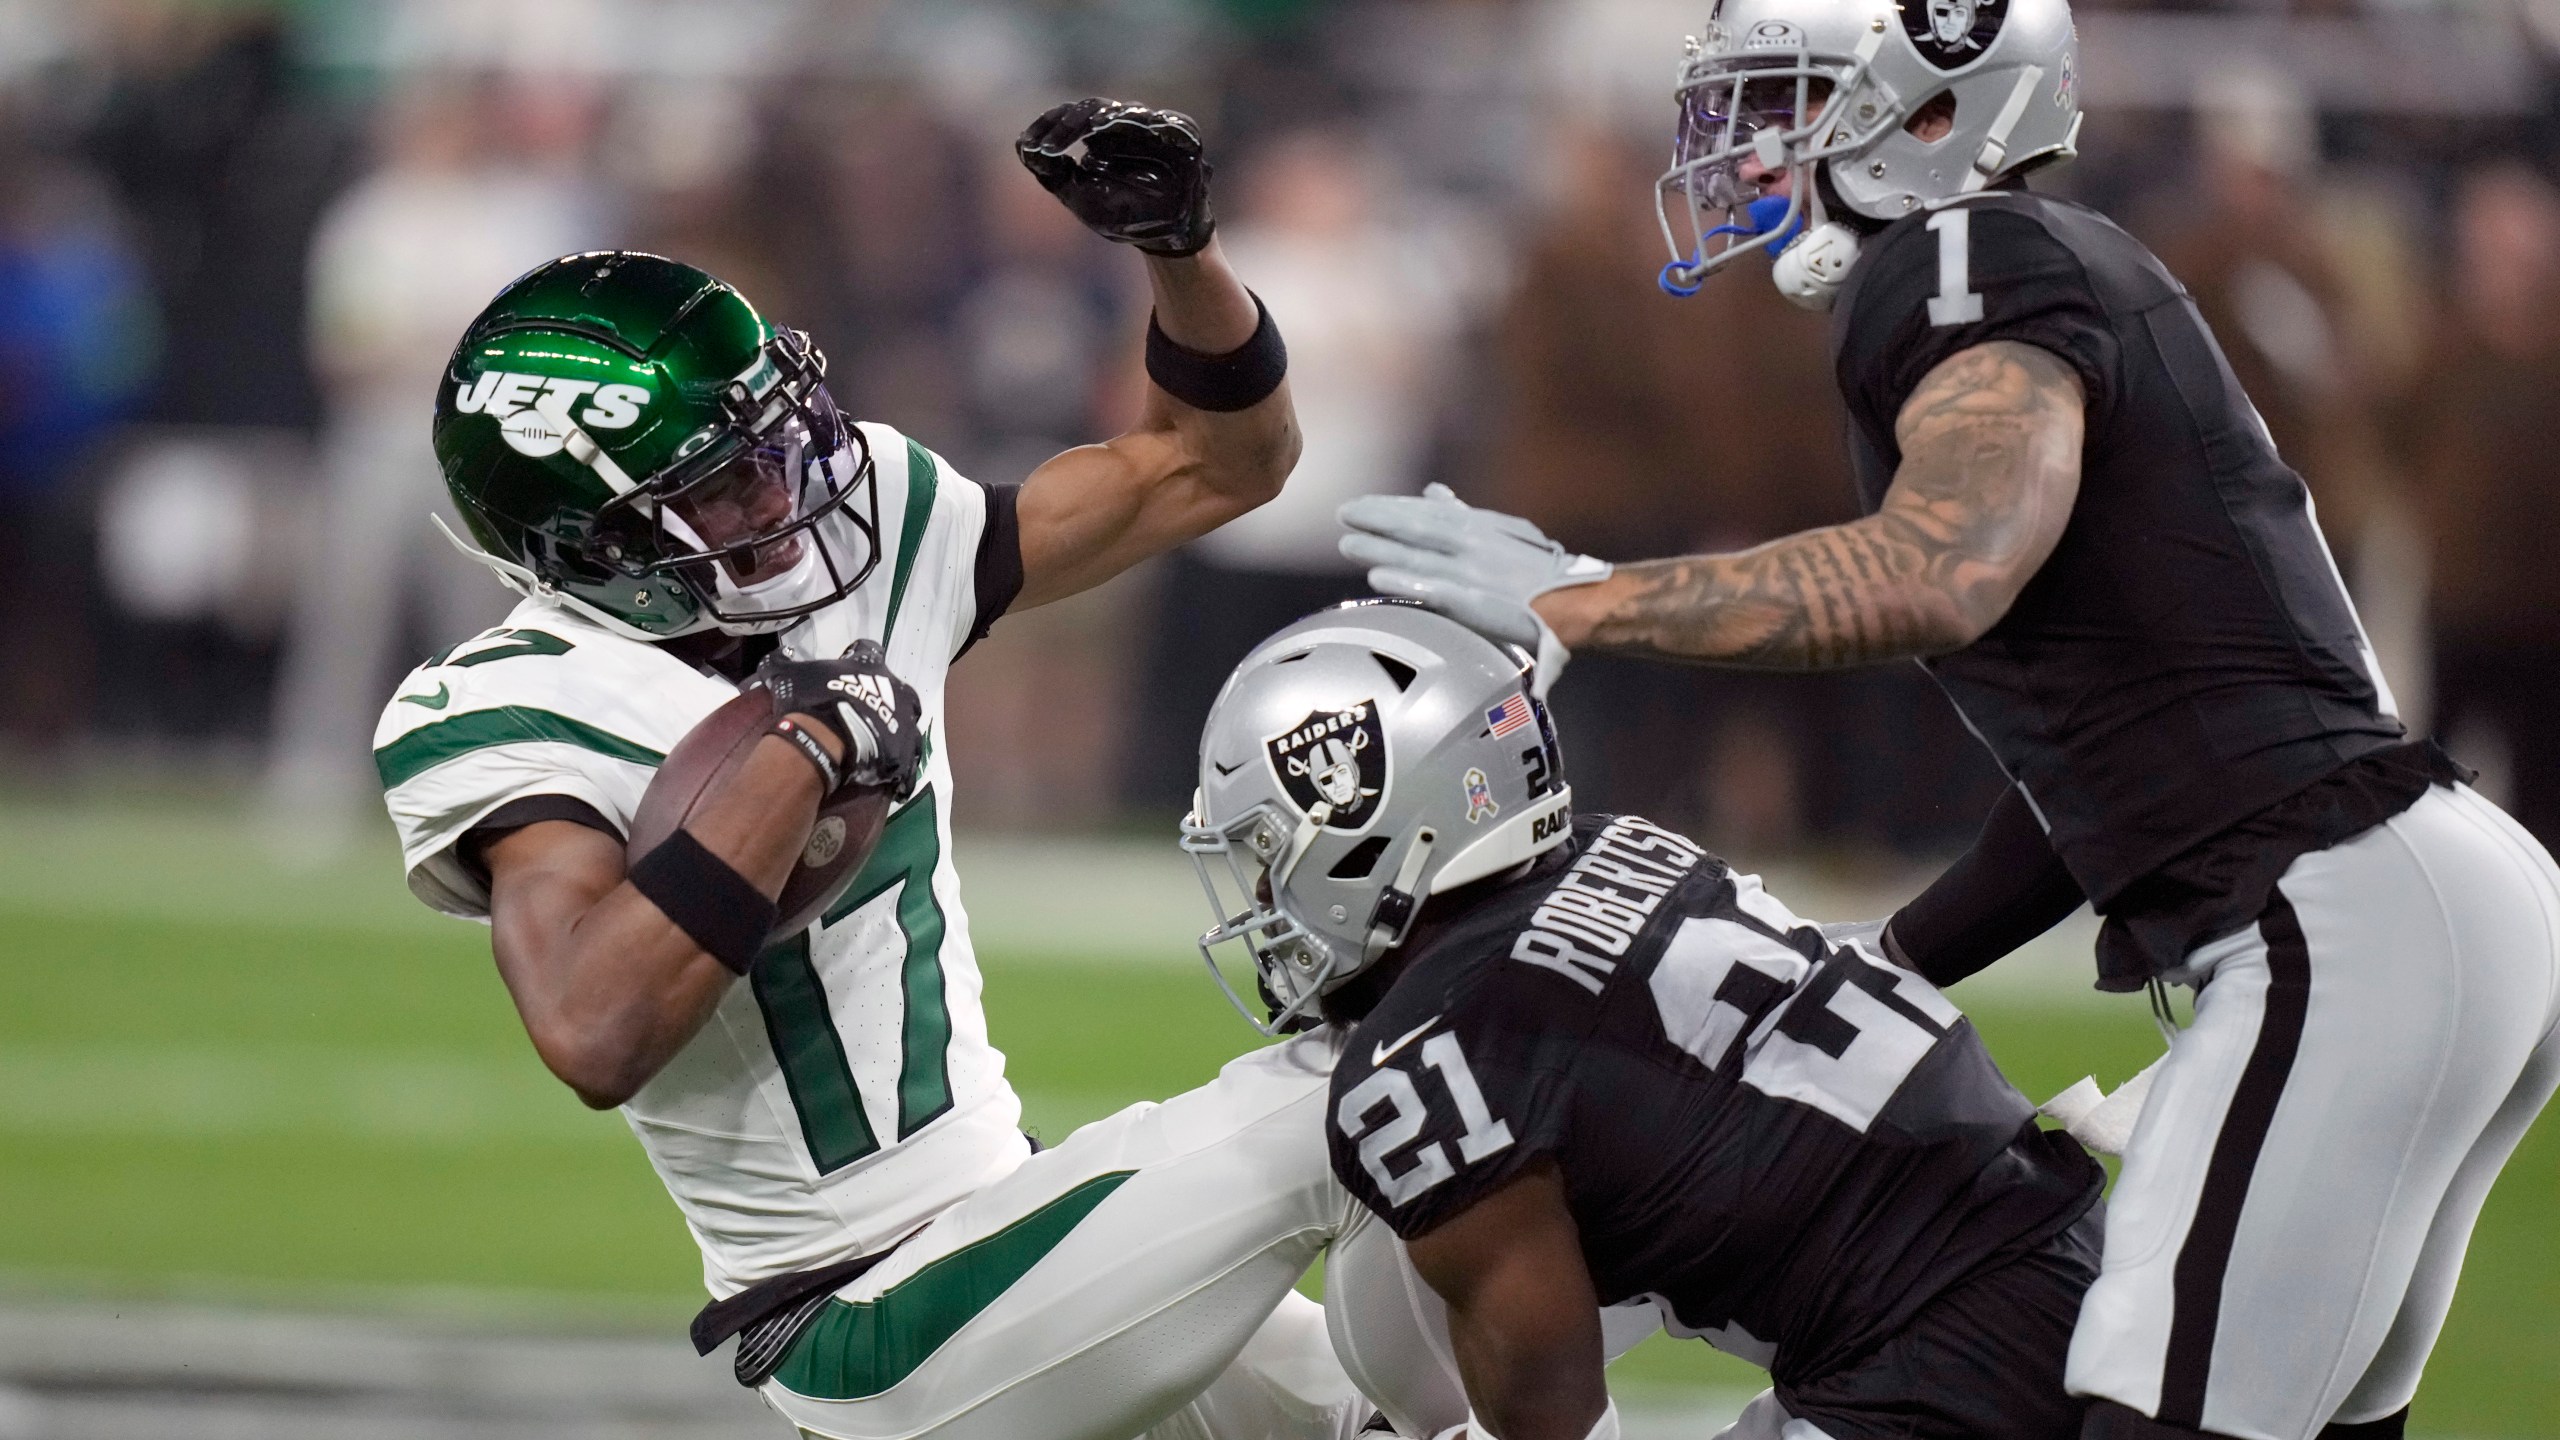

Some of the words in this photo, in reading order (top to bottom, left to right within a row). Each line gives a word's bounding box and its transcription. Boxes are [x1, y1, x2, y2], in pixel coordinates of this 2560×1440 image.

[1925, 207, 1985, 327] 1
[456, 371, 651, 429] JETS
[826, 679, 899, 735] adidas
[1276, 705, 1368, 755] RAIDERS
[750, 781, 955, 1177] 17
[1337, 1029, 1516, 1209] 21
